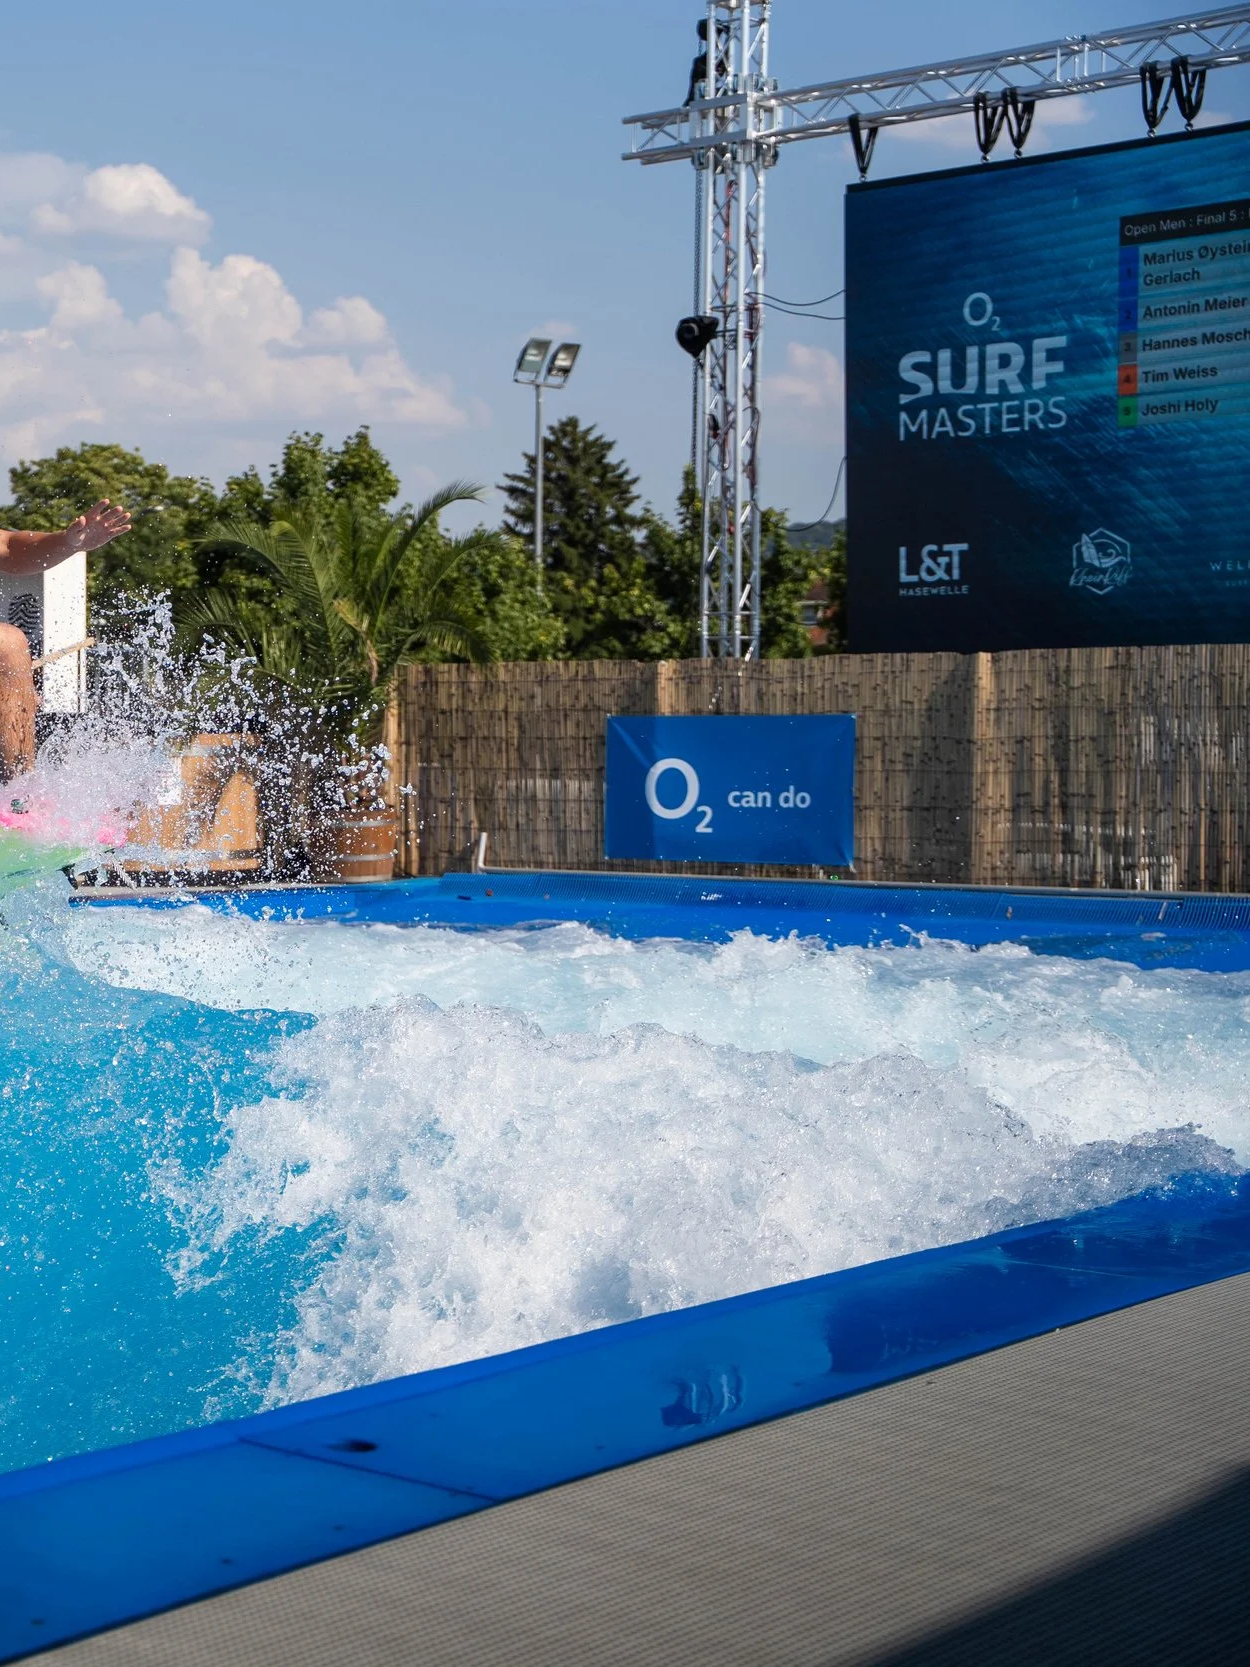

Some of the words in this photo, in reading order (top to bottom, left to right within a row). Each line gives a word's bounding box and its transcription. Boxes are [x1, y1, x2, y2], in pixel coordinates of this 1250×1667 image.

[1124, 222, 1156, 237] Open
[1159, 218, 1186, 231] Men
[1196, 211, 1226, 226] Final
[1230, 209, 1237, 221] 5
[1143, 249, 1194, 266] Marius
[1143, 267, 1201, 287] Gerlach
[1142, 300, 1200, 319] Antonin
[1204, 295, 1248, 312] Meier
[1142, 335, 1198, 352] Hannes
[898, 335, 1067, 405] SURF
[1142, 368, 1169, 383] Tim
[1172, 365, 1218, 381] Weiss
[899, 396, 1067, 441] MASTERS
[1141, 400, 1182, 416] Joshi
[1184, 397, 1219, 414] Holy
[899, 542, 969, 582] L&T
[727, 790, 772, 808] can
[778, 785, 811, 809] do
